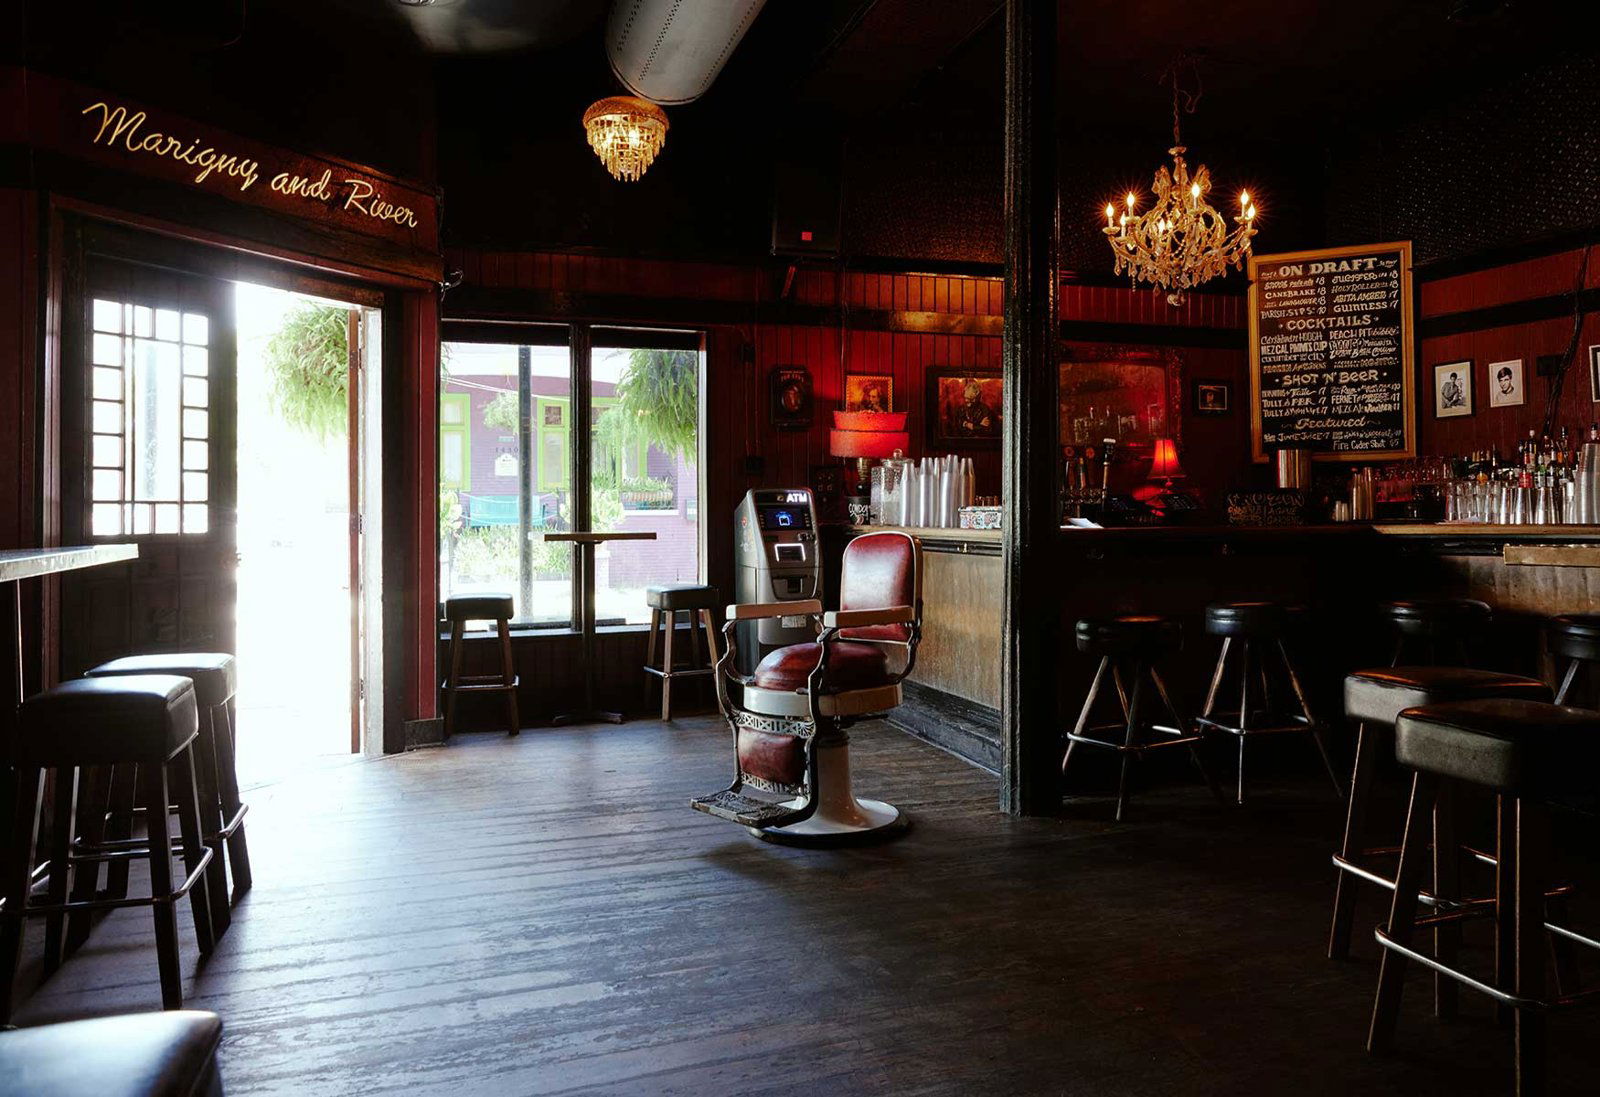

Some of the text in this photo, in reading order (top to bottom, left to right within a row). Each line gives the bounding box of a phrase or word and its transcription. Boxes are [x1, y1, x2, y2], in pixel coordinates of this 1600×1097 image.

[82, 102, 418, 228] Marigny and River
[1279, 265, 1303, 277] ON
[1309, 258, 1377, 274] DRAFT
[1331, 285, 1350, 294] HOLY
[1350, 283, 1379, 292] ROLLER
[1334, 293, 1357, 303] ABITA
[1357, 291, 1386, 300] AMBER
[1334, 301, 1388, 313] GUINNESS
[1286, 314, 1372, 330] COCKTAILS
[1330, 329, 1357, 340] PEACH
[1358, 328, 1372, 337] PIT
[1261, 344, 1288, 355] MEZCAL
[1313, 341, 1327, 351] CUP
[1282, 374, 1319, 386] SHOT
[1295, 416, 1366, 429] Featured
[786, 493, 808, 503] ATM
